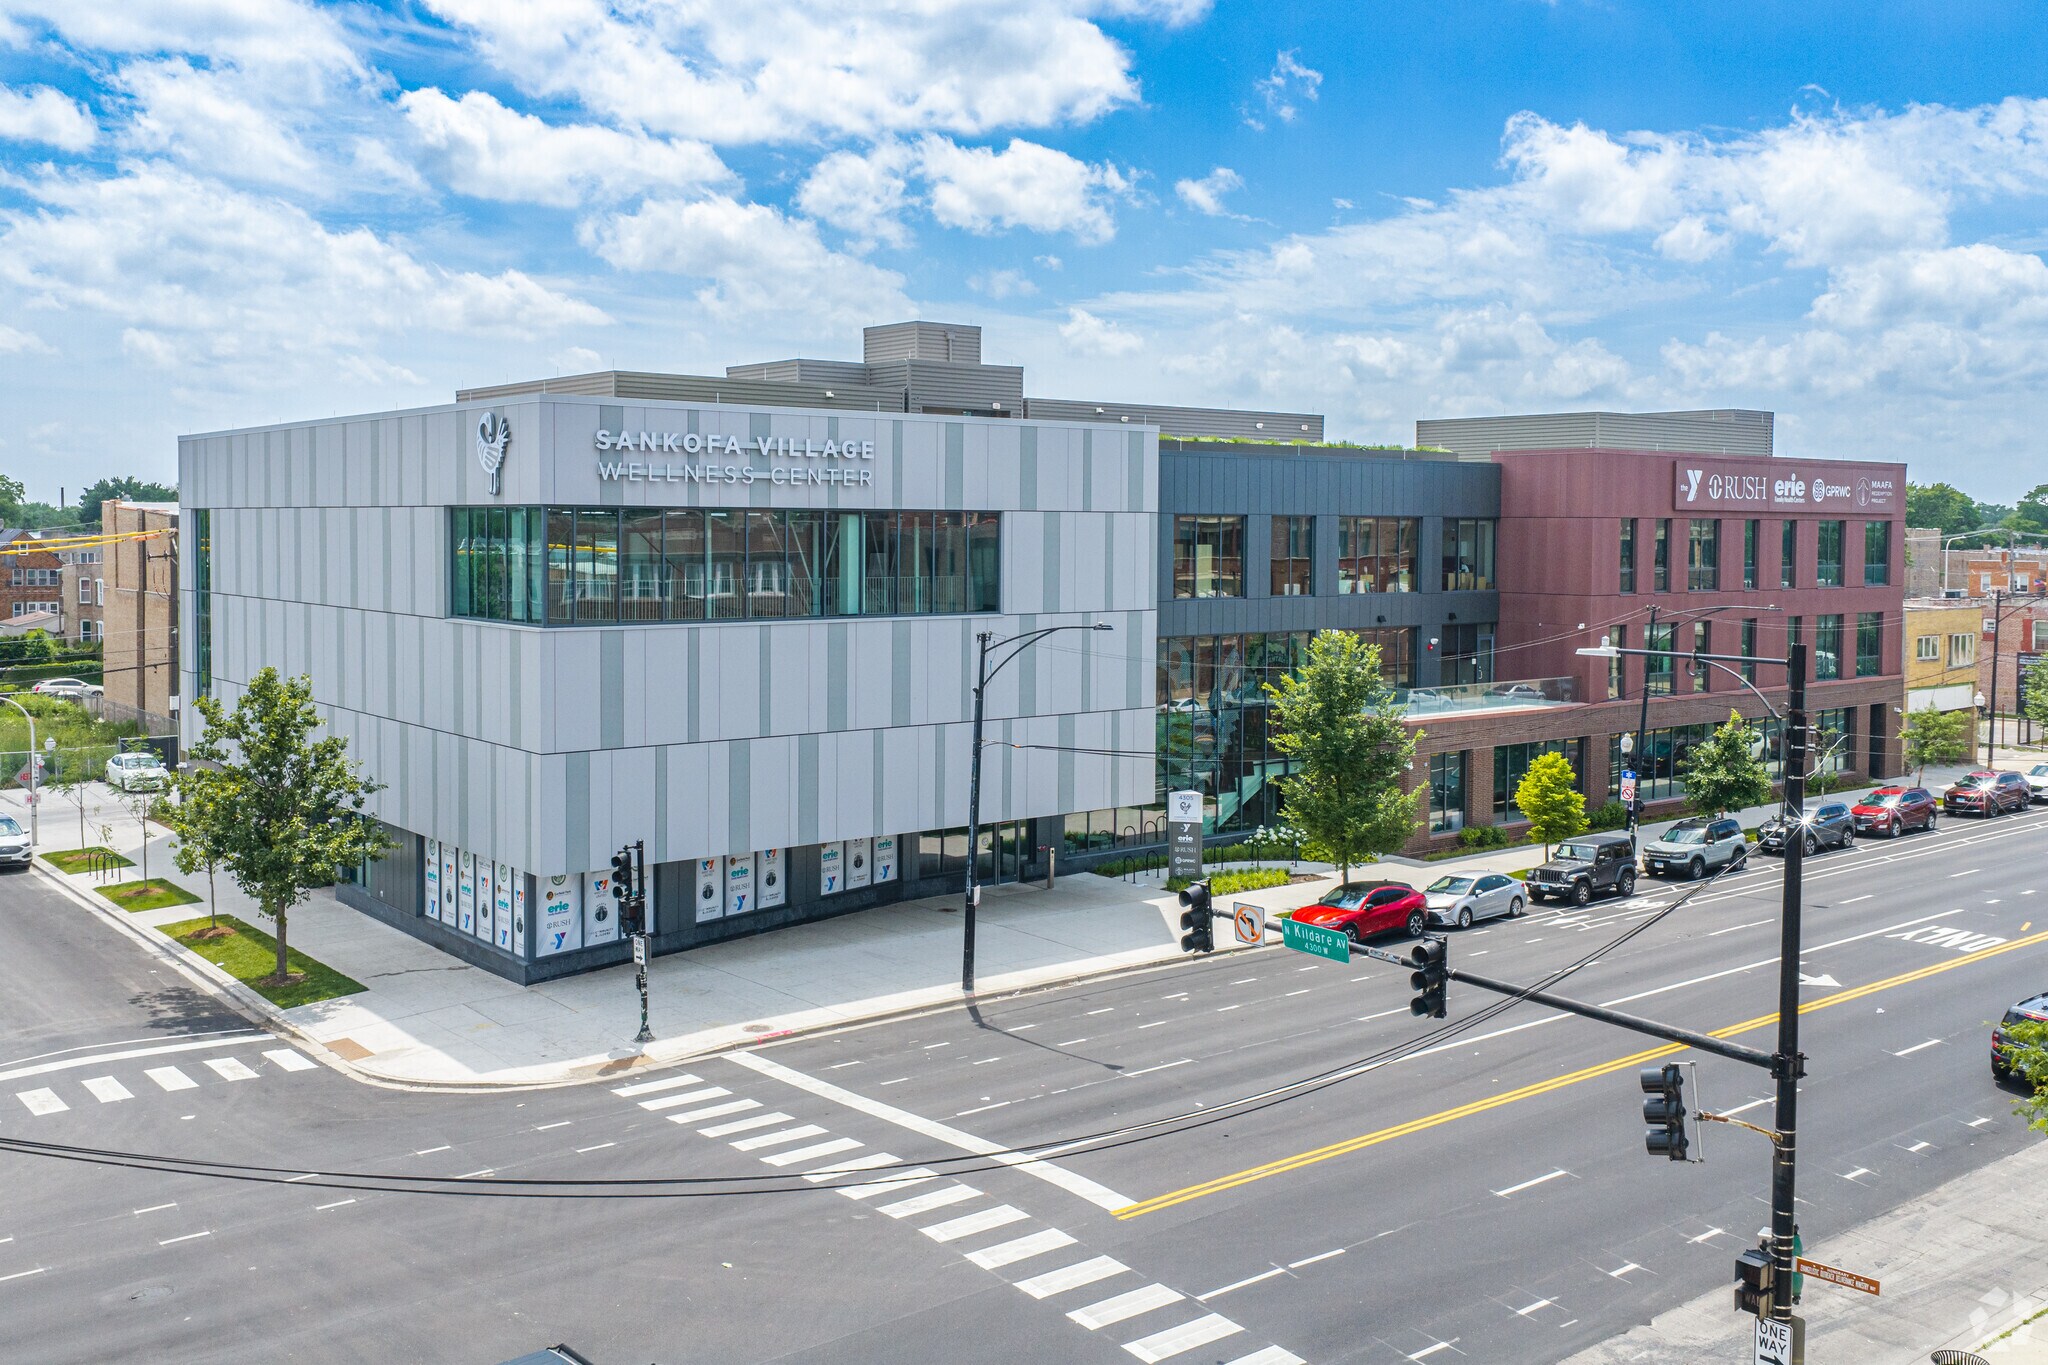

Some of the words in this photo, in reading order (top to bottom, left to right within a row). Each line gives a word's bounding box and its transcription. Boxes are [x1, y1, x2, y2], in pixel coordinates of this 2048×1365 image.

[595, 430, 741, 454] SANKOFA
[757, 436, 874, 459] VILLAGE
[598, 462, 754, 484] WELLNESS
[771, 467, 872, 486] CENTER
[1680, 484, 1689, 492] the
[1724, 475, 1767, 500] RUSH
[1774, 473, 1806, 497] erie
[1871, 480, 1893, 489] MAAFA
[1825, 485, 1851, 498] GPRWC
[877, 839, 893, 849] erie
[822, 849, 839, 860] erie
[731, 866, 749, 878] erie
[461, 883, 472, 895] erie
[497, 898, 509, 909] erie
[547, 901, 570, 913] erie
[552, 918, 571, 928] RUSH
[1284, 925, 1290, 935] N
[1294, 924, 1332, 946] Kildare
[1336, 938, 1346, 949] AV
[1884, 925, 2009, 952] ONLY
[1304, 942, 1322, 953] 4300
[1760, 1322, 1787, 1342] ONE
[1759, 1335, 1787, 1355] WAY
